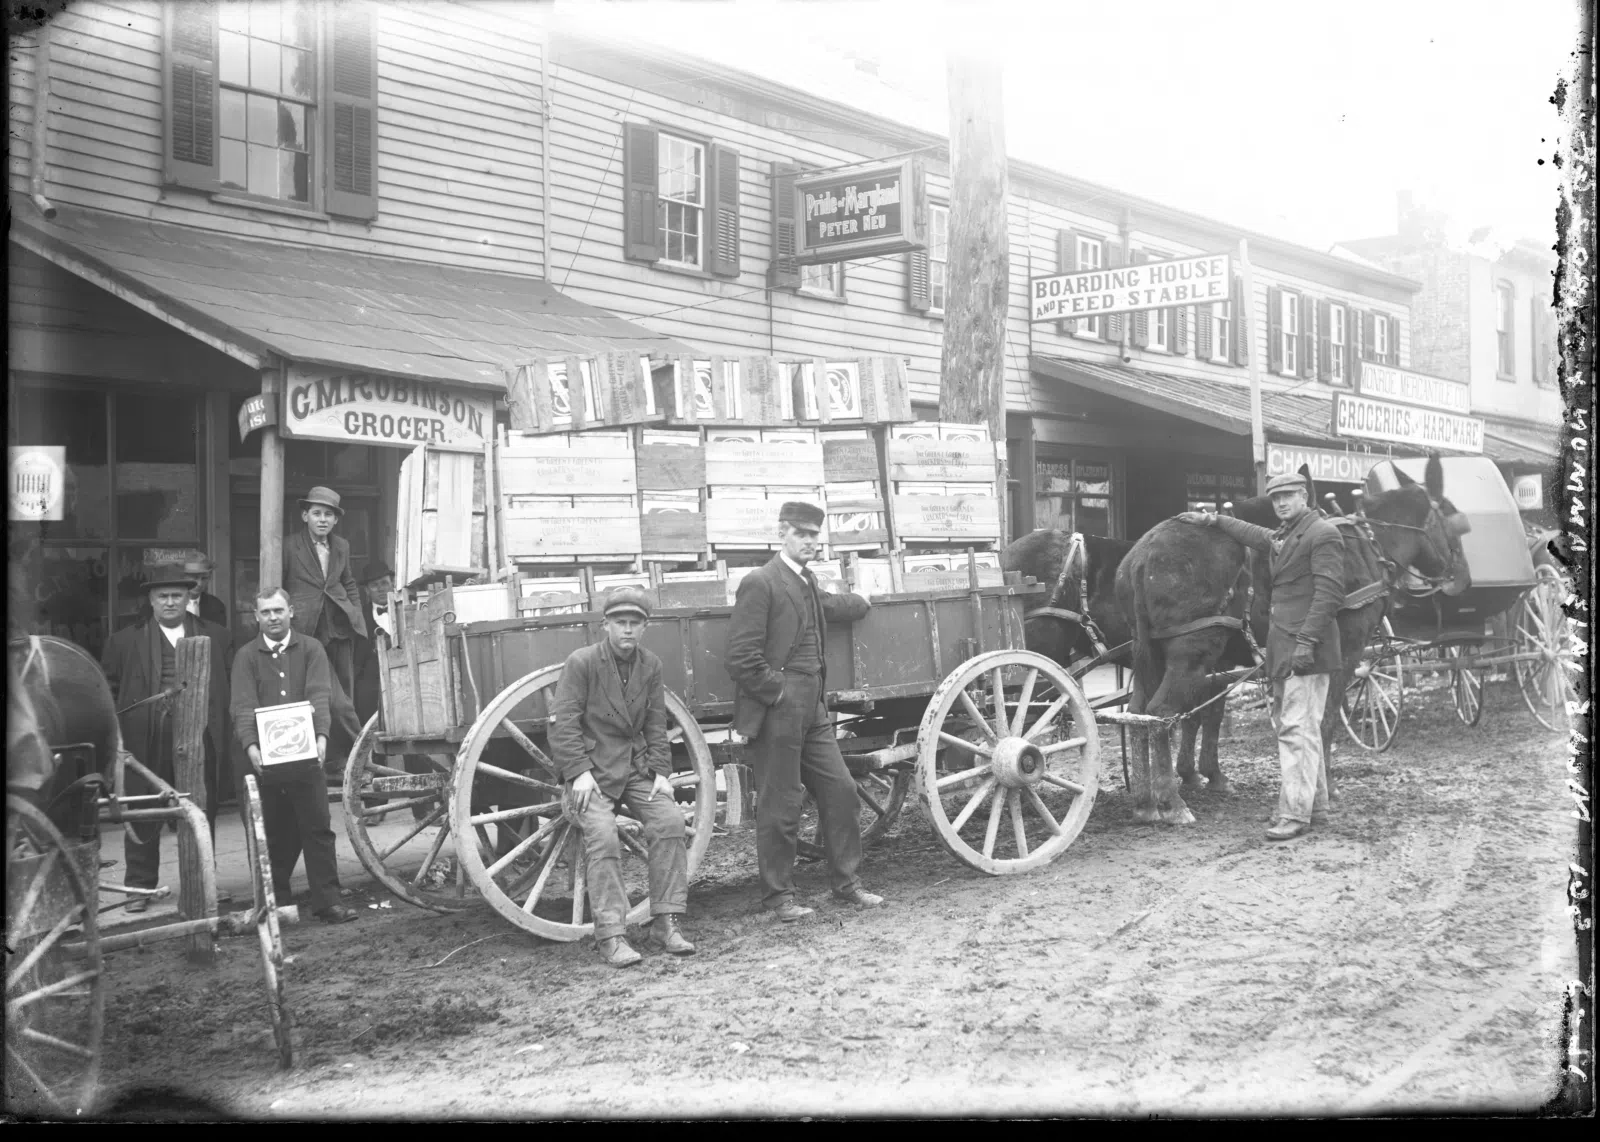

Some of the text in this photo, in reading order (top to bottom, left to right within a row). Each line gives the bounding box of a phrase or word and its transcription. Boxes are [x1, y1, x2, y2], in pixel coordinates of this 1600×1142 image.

[806, 191, 838, 221] Pride
[845, 181, 900, 216] Maryland
[820, 214, 886, 238] PETER NEU
[1035, 258, 1224, 299] BOARDING HOUSE
[1036, 300, 1055, 318] AND
[1057, 294, 1115, 314] FEED
[1360, 365, 1396, 395] MONROE
[344, 410, 453, 443] GROCER.
[1339, 399, 1411, 437] GROCERIES
[1270, 448, 1363, 479] CHAMPION
